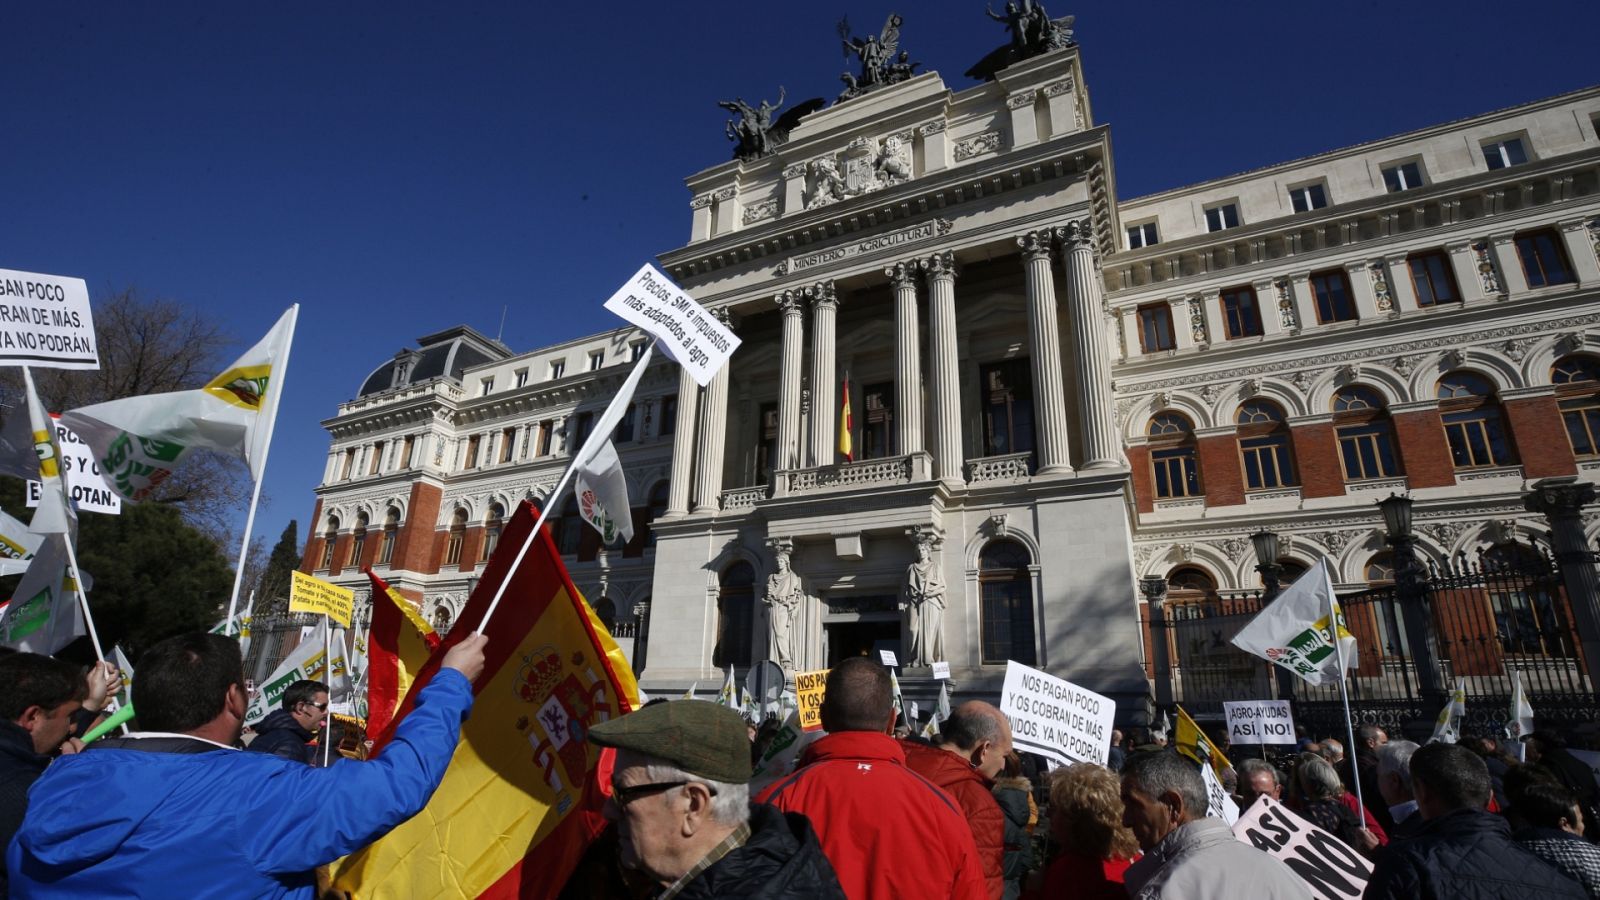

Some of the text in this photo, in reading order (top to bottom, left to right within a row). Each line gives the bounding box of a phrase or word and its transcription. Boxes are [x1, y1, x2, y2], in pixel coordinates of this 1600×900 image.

[794, 249, 846, 270] MINISTERIO
[858, 226, 930, 254] AGRICULTURA
[26, 282, 64, 302] POCO
[32, 307, 50, 326] DE
[51, 306, 84, 329] MÁS.
[637, 271, 731, 354] Precios, SMI e impuestos
[16, 331, 37, 350] NO
[38, 332, 94, 353] PODRÁN.
[623, 294, 709, 369] más adaptados al agro.
[77, 457, 87, 473] Y
[797, 674, 815, 689] NOS
[800, 694, 806, 709] Y
[808, 692, 820, 707] OS
[1022, 674, 1099, 715] NOS PAGAN POCO
[803, 711, 816, 724] ¡NO
[1009, 692, 1104, 742] Y OS COBRAN DE MÁS.
[1043, 725, 1054, 743] YA
[1057, 729, 1068, 748] NO
[1233, 721, 1291, 738] ASÍ, NO!
